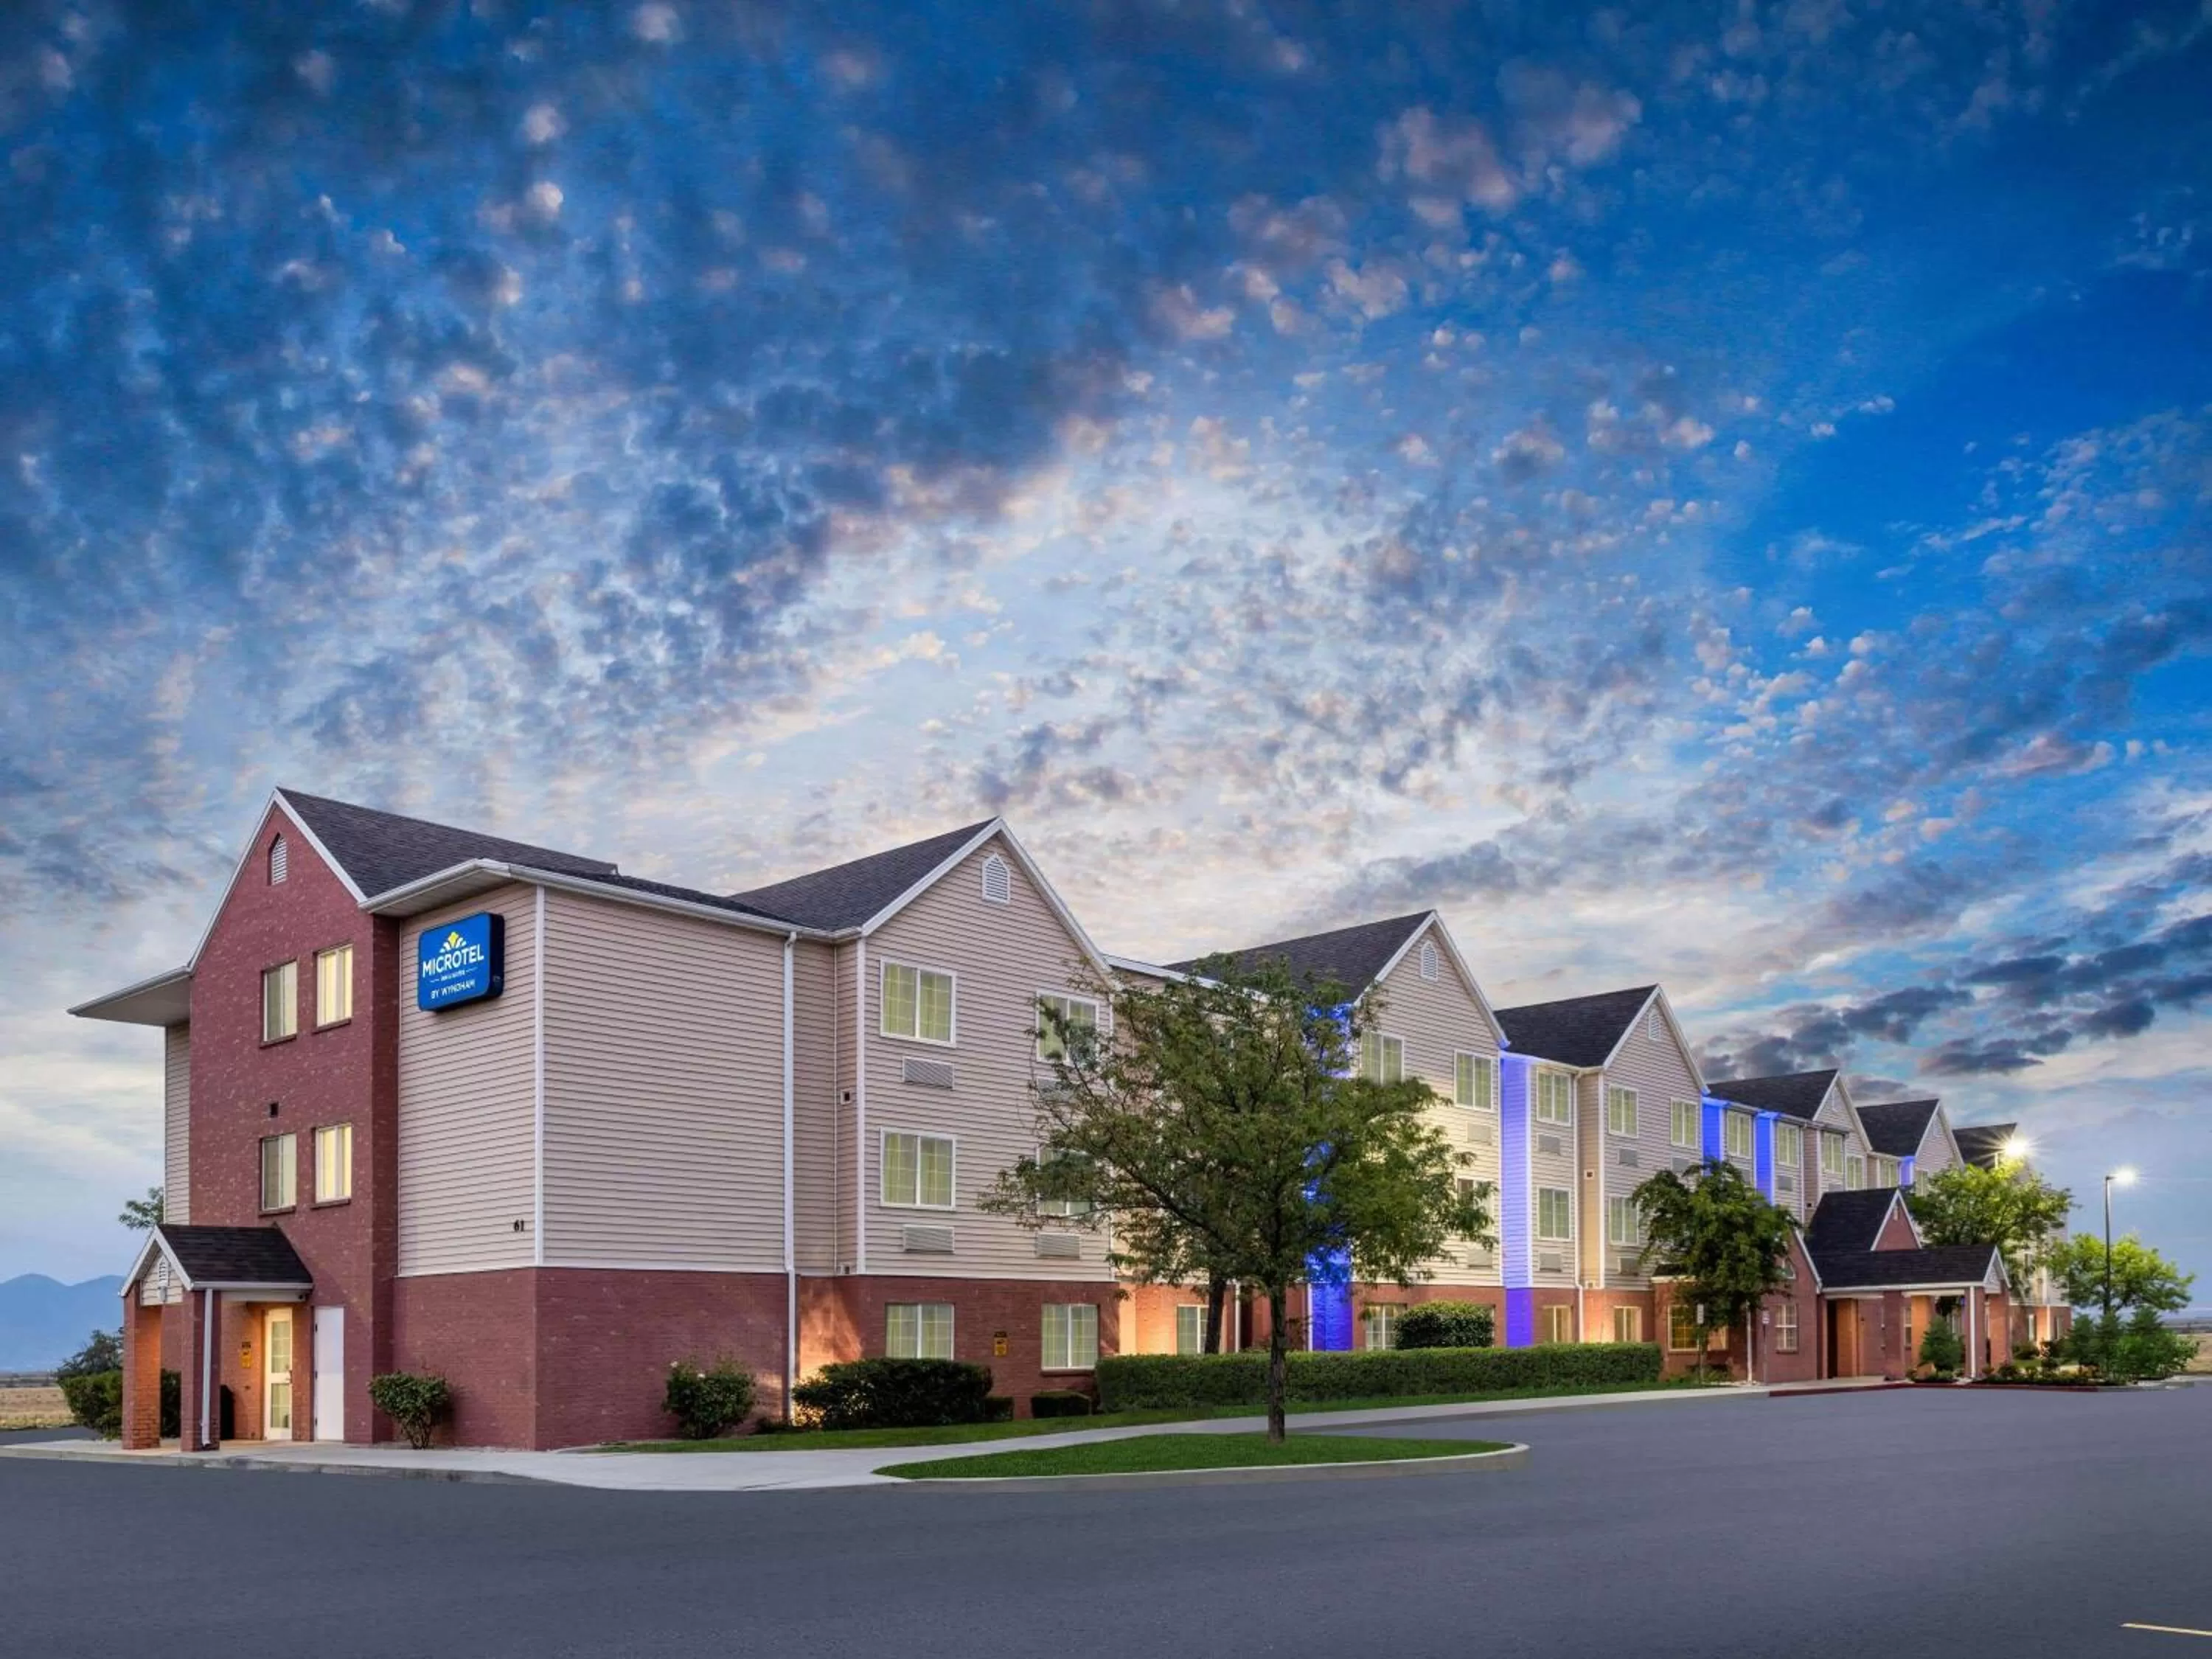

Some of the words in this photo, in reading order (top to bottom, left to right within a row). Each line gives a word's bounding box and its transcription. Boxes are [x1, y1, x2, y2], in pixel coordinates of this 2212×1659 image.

[422, 944, 484, 978] MICROTEL
[431, 989, 439, 999] BY
[441, 978, 476, 996] WYNDHAM
